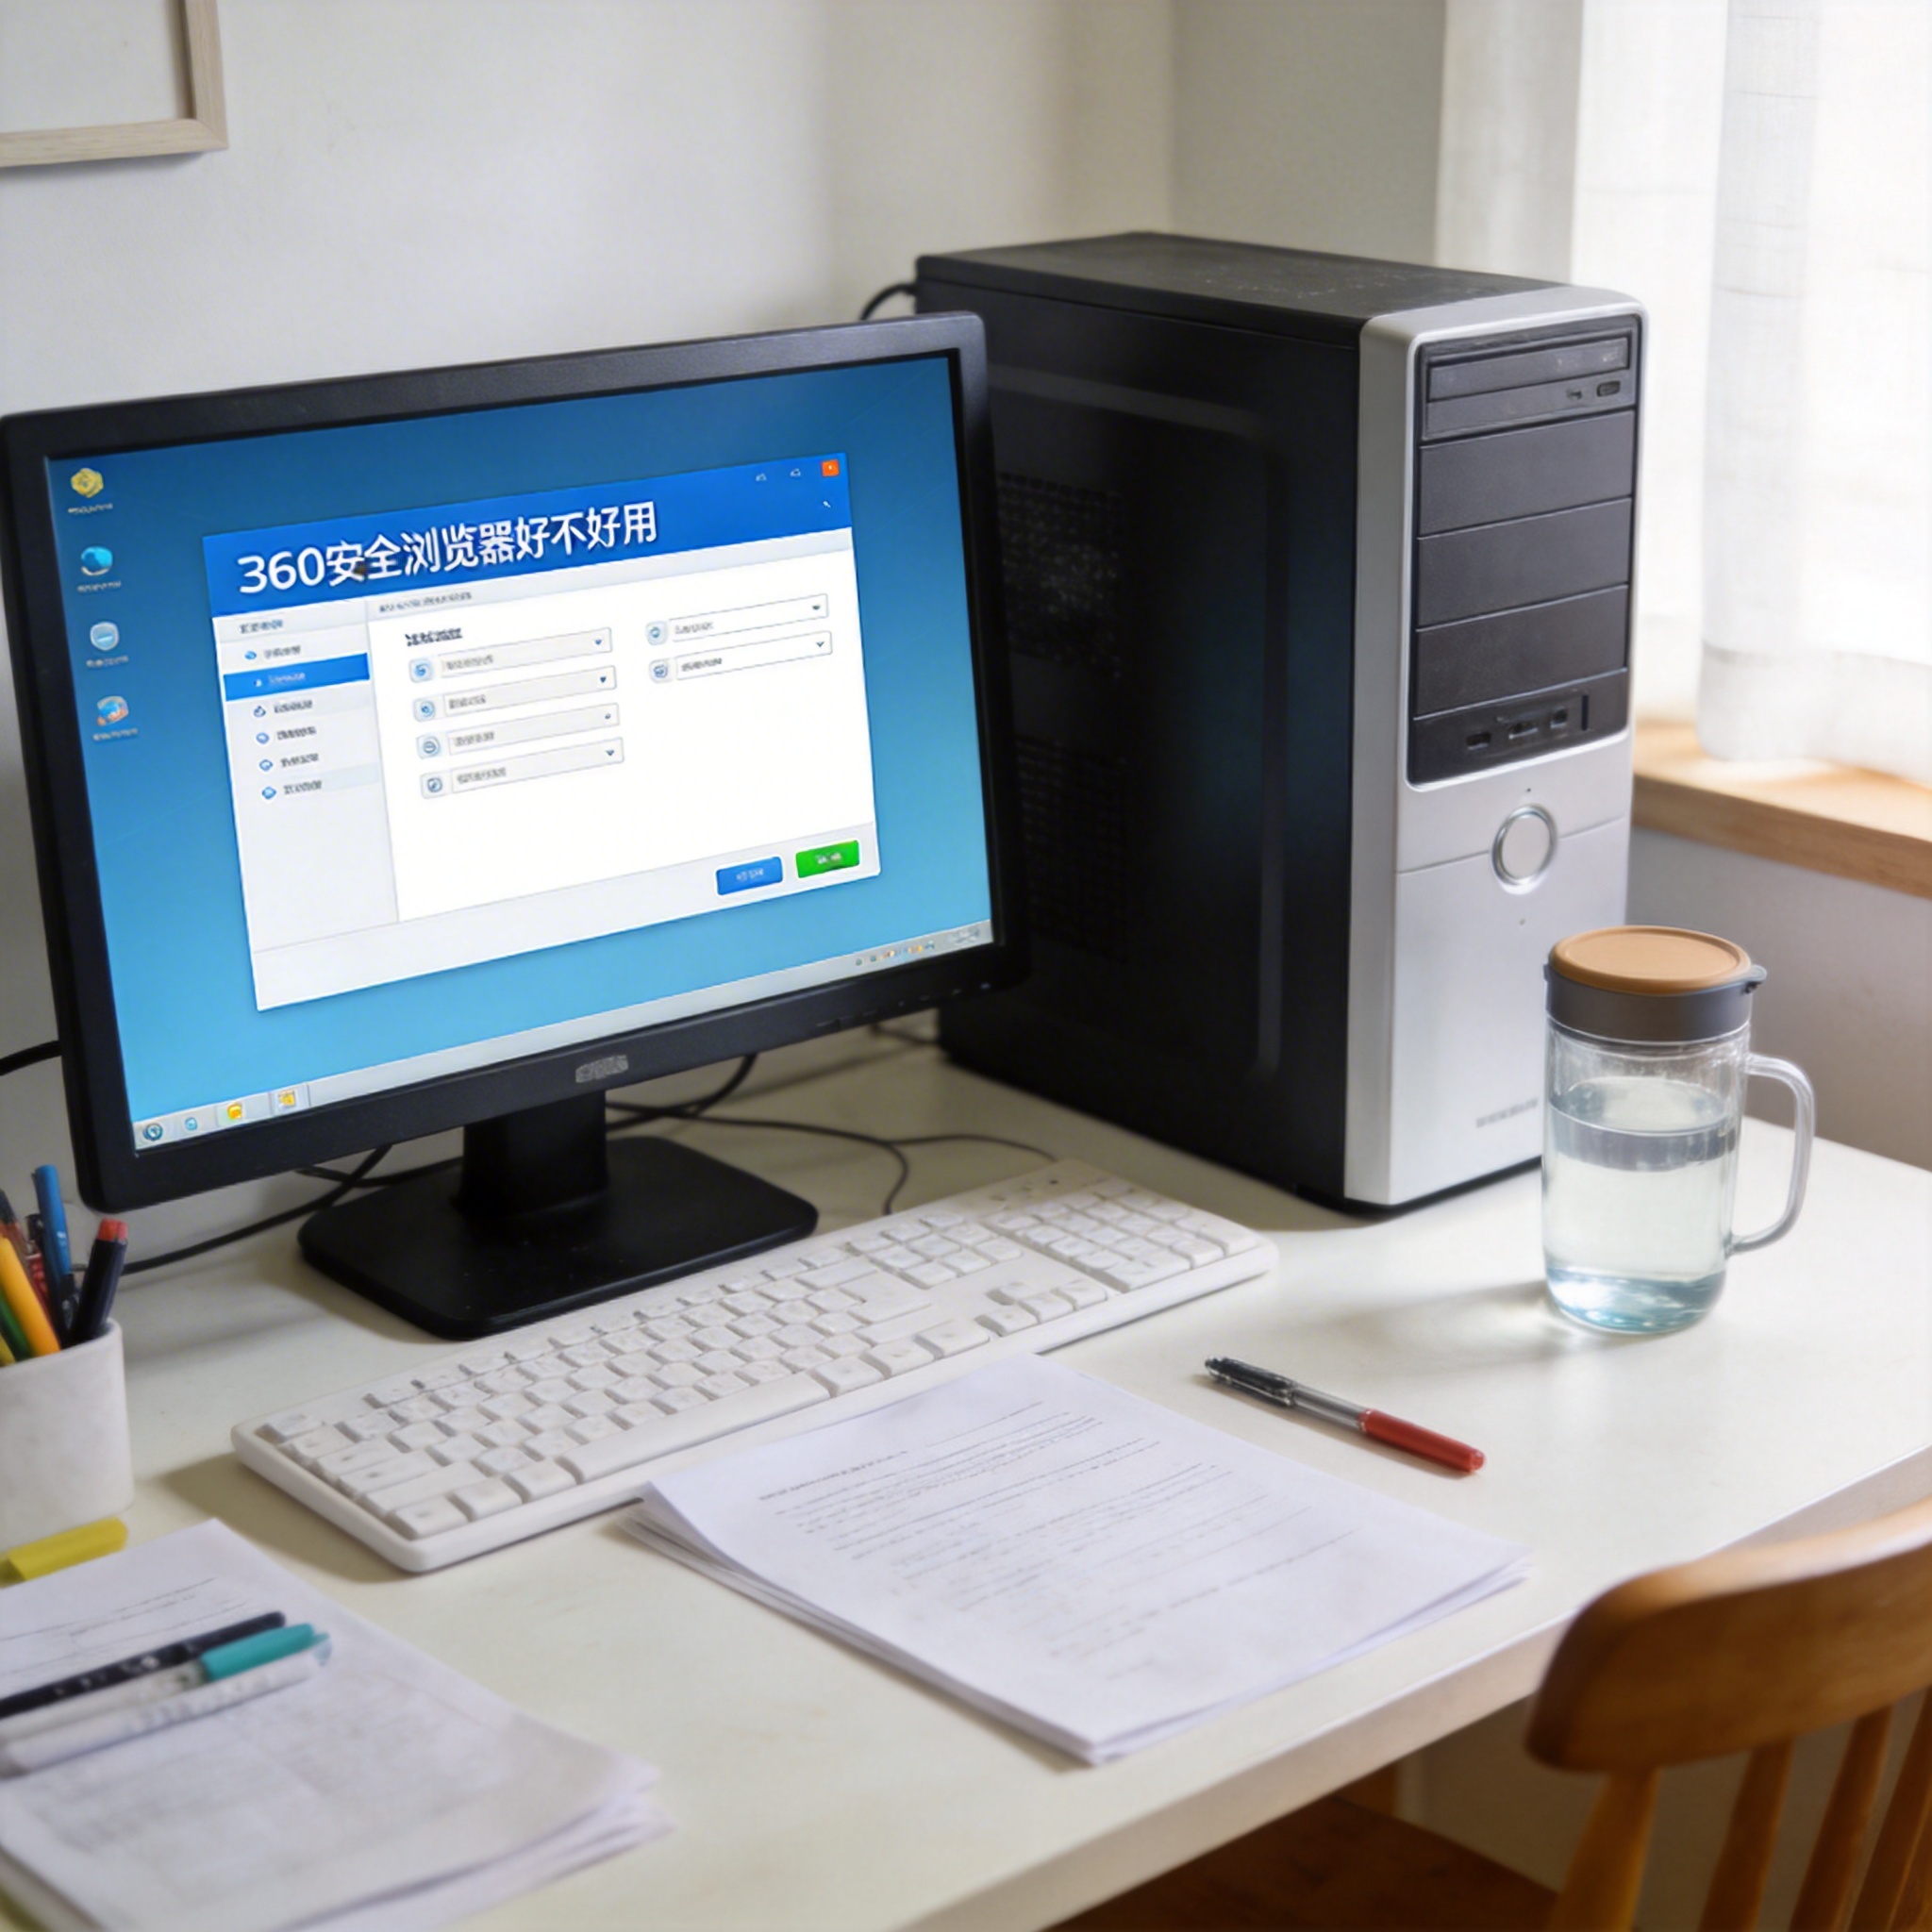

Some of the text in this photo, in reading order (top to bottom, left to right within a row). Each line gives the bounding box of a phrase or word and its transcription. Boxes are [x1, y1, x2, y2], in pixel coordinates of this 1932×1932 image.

[238, 501, 658, 592] 360安全浏览器好不好用
